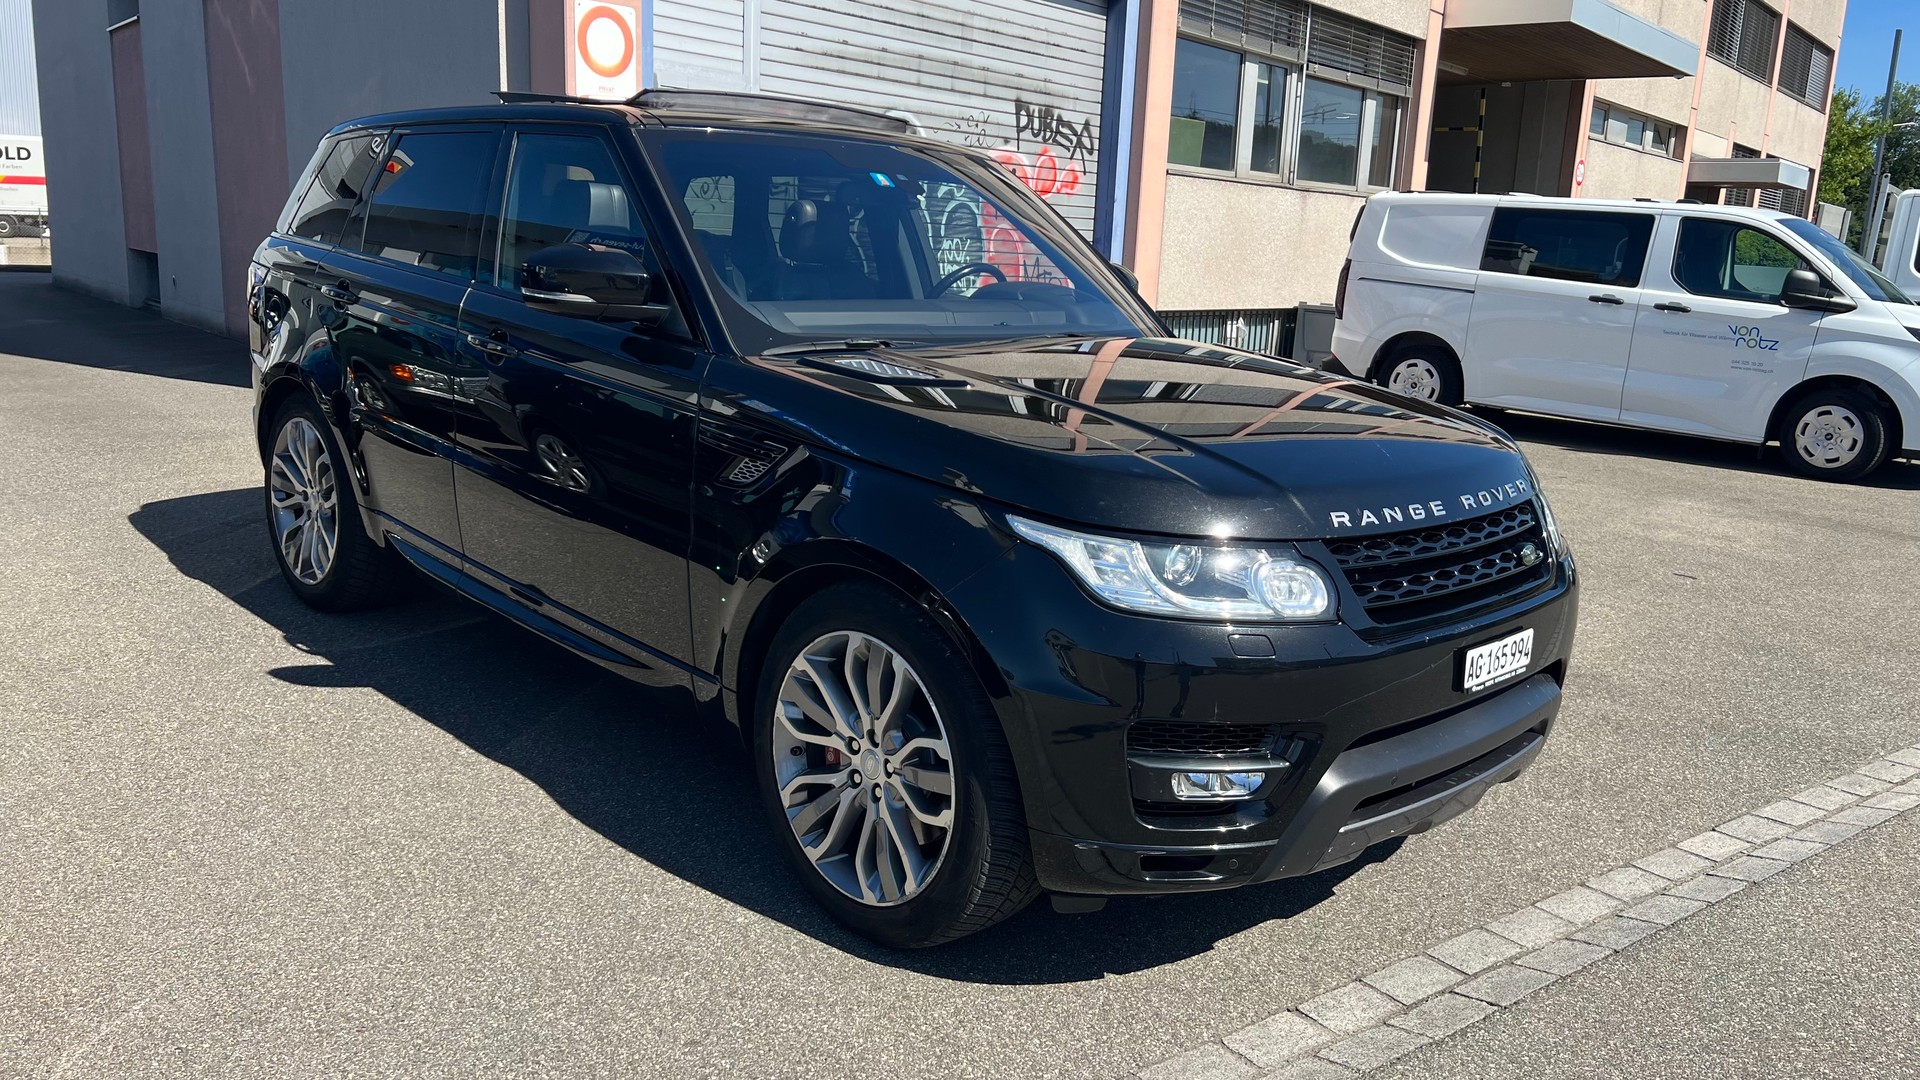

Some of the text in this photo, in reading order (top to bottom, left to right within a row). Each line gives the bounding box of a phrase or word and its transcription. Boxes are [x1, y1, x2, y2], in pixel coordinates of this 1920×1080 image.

[1728, 325, 1760, 337] von
[1735, 335, 1779, 351] rotz
[1329, 478, 1527, 528] RANGE ROVER
